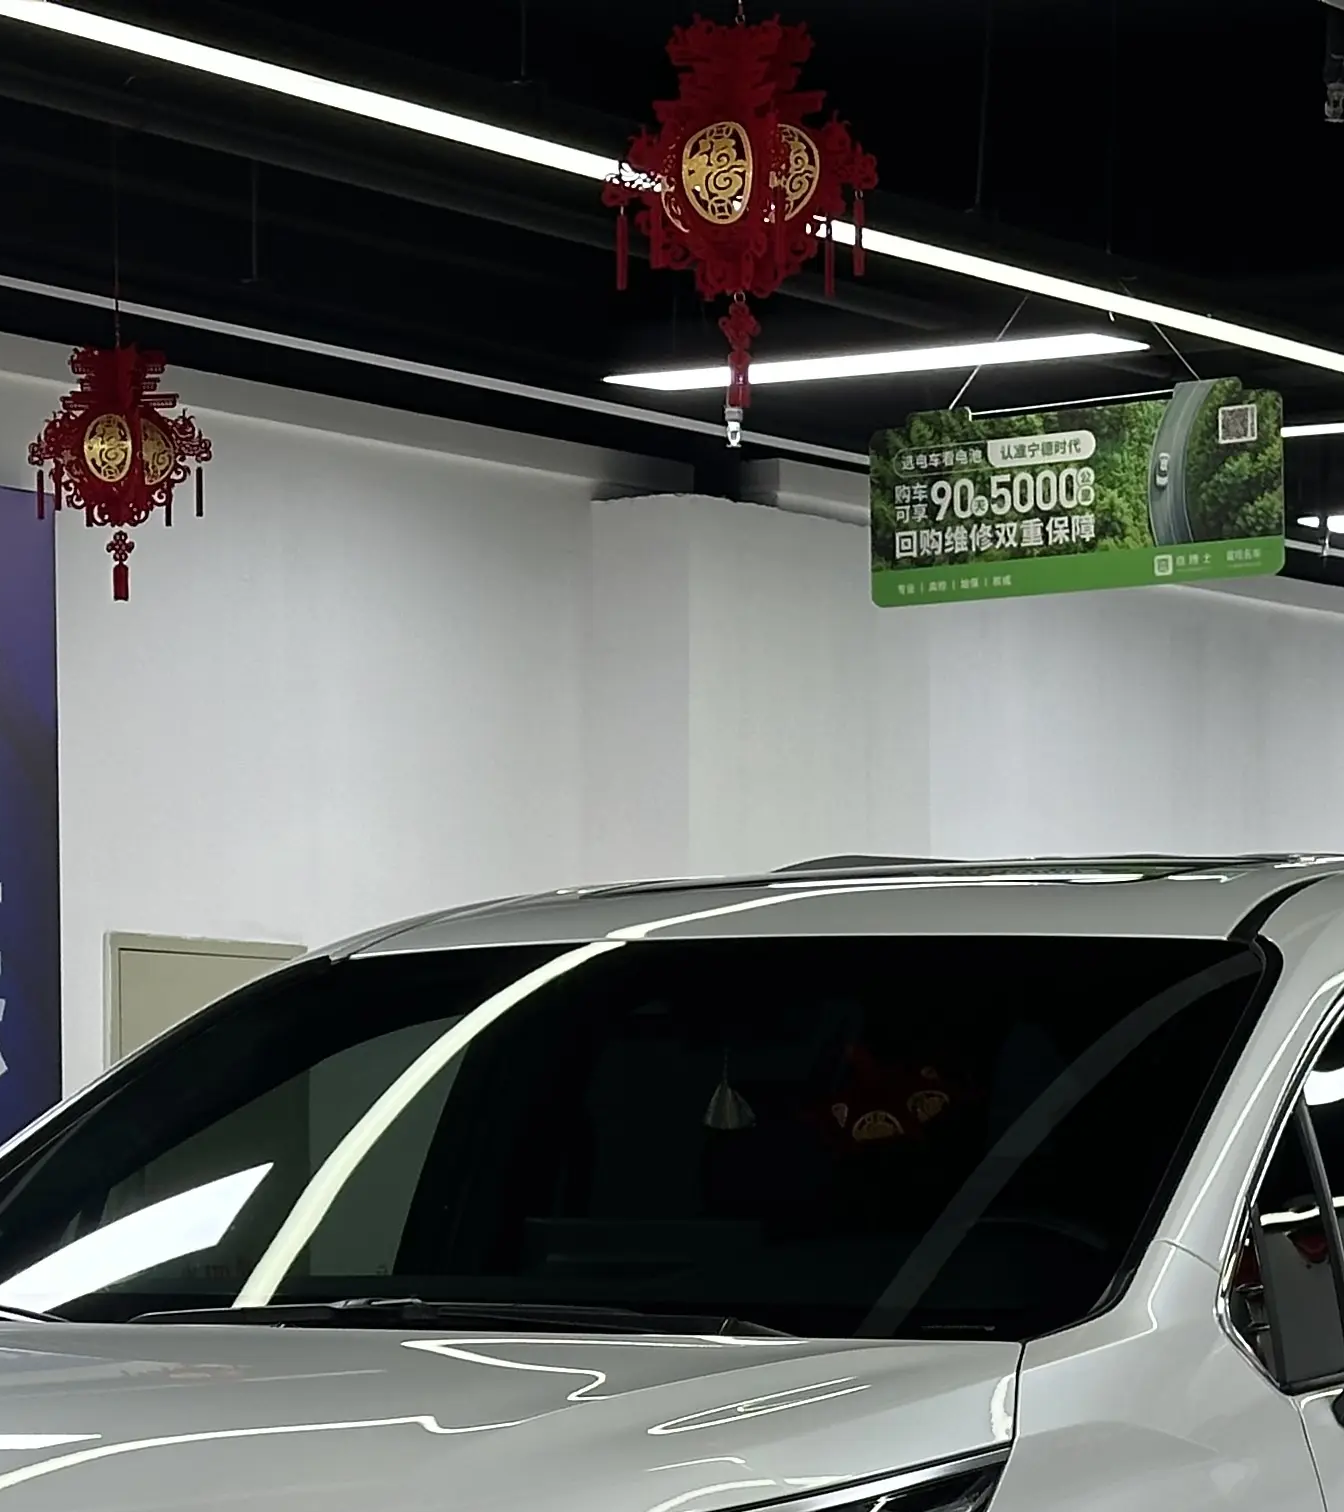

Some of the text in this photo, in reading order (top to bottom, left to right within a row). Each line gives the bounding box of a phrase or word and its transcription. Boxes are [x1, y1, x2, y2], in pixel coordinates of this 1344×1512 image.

[895, 513, 1097, 559] 回购维修双重保障
